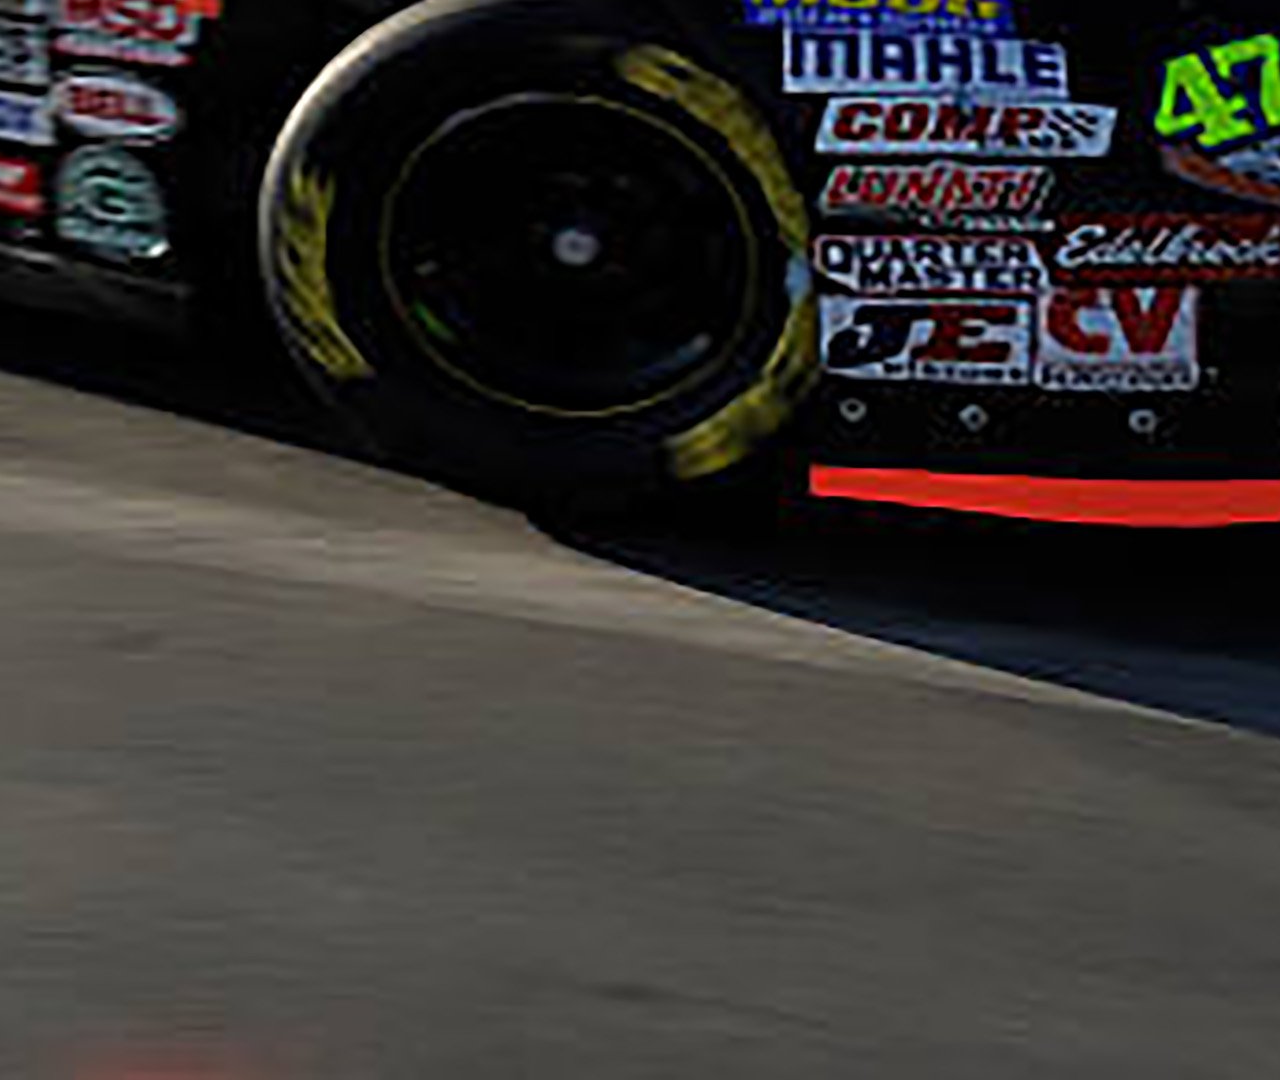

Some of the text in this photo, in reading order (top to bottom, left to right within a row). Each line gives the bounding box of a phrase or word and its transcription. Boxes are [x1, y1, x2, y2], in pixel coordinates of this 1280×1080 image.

[790, 32, 1062, 88] MAHLE
[832, 102, 1045, 146] COMP
[822, 238, 1030, 270] QUARTER
[827, 303, 1020, 369] JE
[1046, 288, 1182, 356] CV
